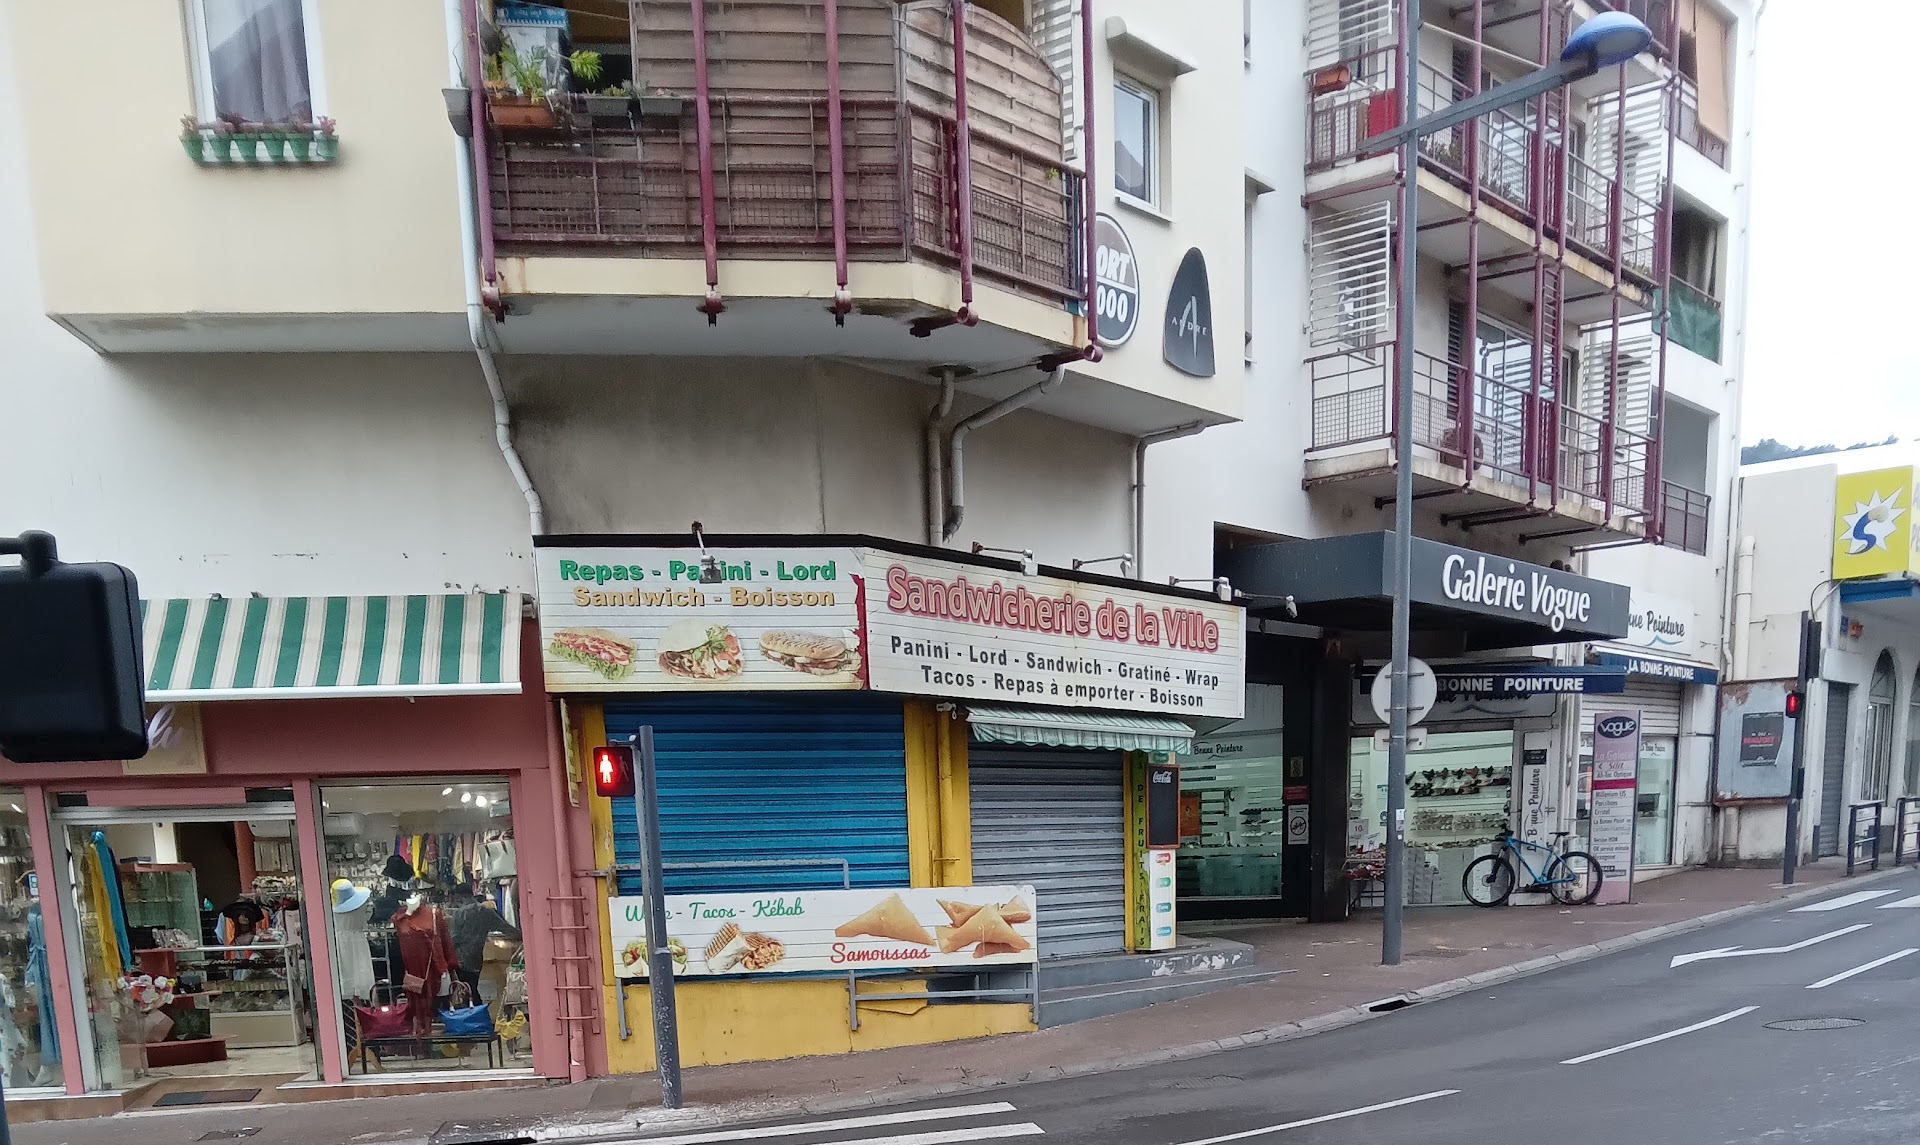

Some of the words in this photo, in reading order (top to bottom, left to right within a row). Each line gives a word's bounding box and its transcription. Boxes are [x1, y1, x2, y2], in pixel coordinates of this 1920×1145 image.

[1096, 245, 1130, 284] ORT
[1097, 285, 1128, 323] 000
[560, 560, 644, 585] Repas
[670, 560, 750, 581] Paini
[777, 560, 836, 582] Lord
[573, 587, 705, 607] Sandwich
[730, 587, 835, 607] Boisson
[885, 562, 1092, 636] Sandwicherie
[1096, 598, 1130, 641] de
[1135, 603, 1161, 646] la
[1162, 605, 1219, 652] Ville
[1442, 554, 1526, 611] Galerie
[1531, 571, 1591, 633] Vogue
[1646, 610, 1686, 637] Pointure
[891, 635, 950, 660] Panini
[969, 645, 1007, 667] Lord
[1026, 652, 1101, 675] Sandwich
[1117, 662, 1171, 683] Gratiné
[1185, 669, 1219, 690] Wrap
[1627, 659, 1639, 674] LA
[1640, 660, 1663, 676] BONNE
[1663, 665, 1694, 680] POINTURE
[921, 665, 975, 687] Tacos
[994, 672, 1044, 696] Repas
[1050, 679, 1059, 695] à
[1065, 684, 1135, 704] emporter
[1149, 688, 1204, 707] Boisson
[1437, 677, 1494, 692] BONNE
[1503, 677, 1585, 692] POINTURE
[1600, 720, 1635, 736] vogue
[1528, 767, 1540, 806] Pointure
[1137, 817, 1145, 880] FRUITS
[689, 902, 736, 920] Tacos
[752, 897, 805, 918] Kébab
[829, 942, 931, 964] Samoussas
